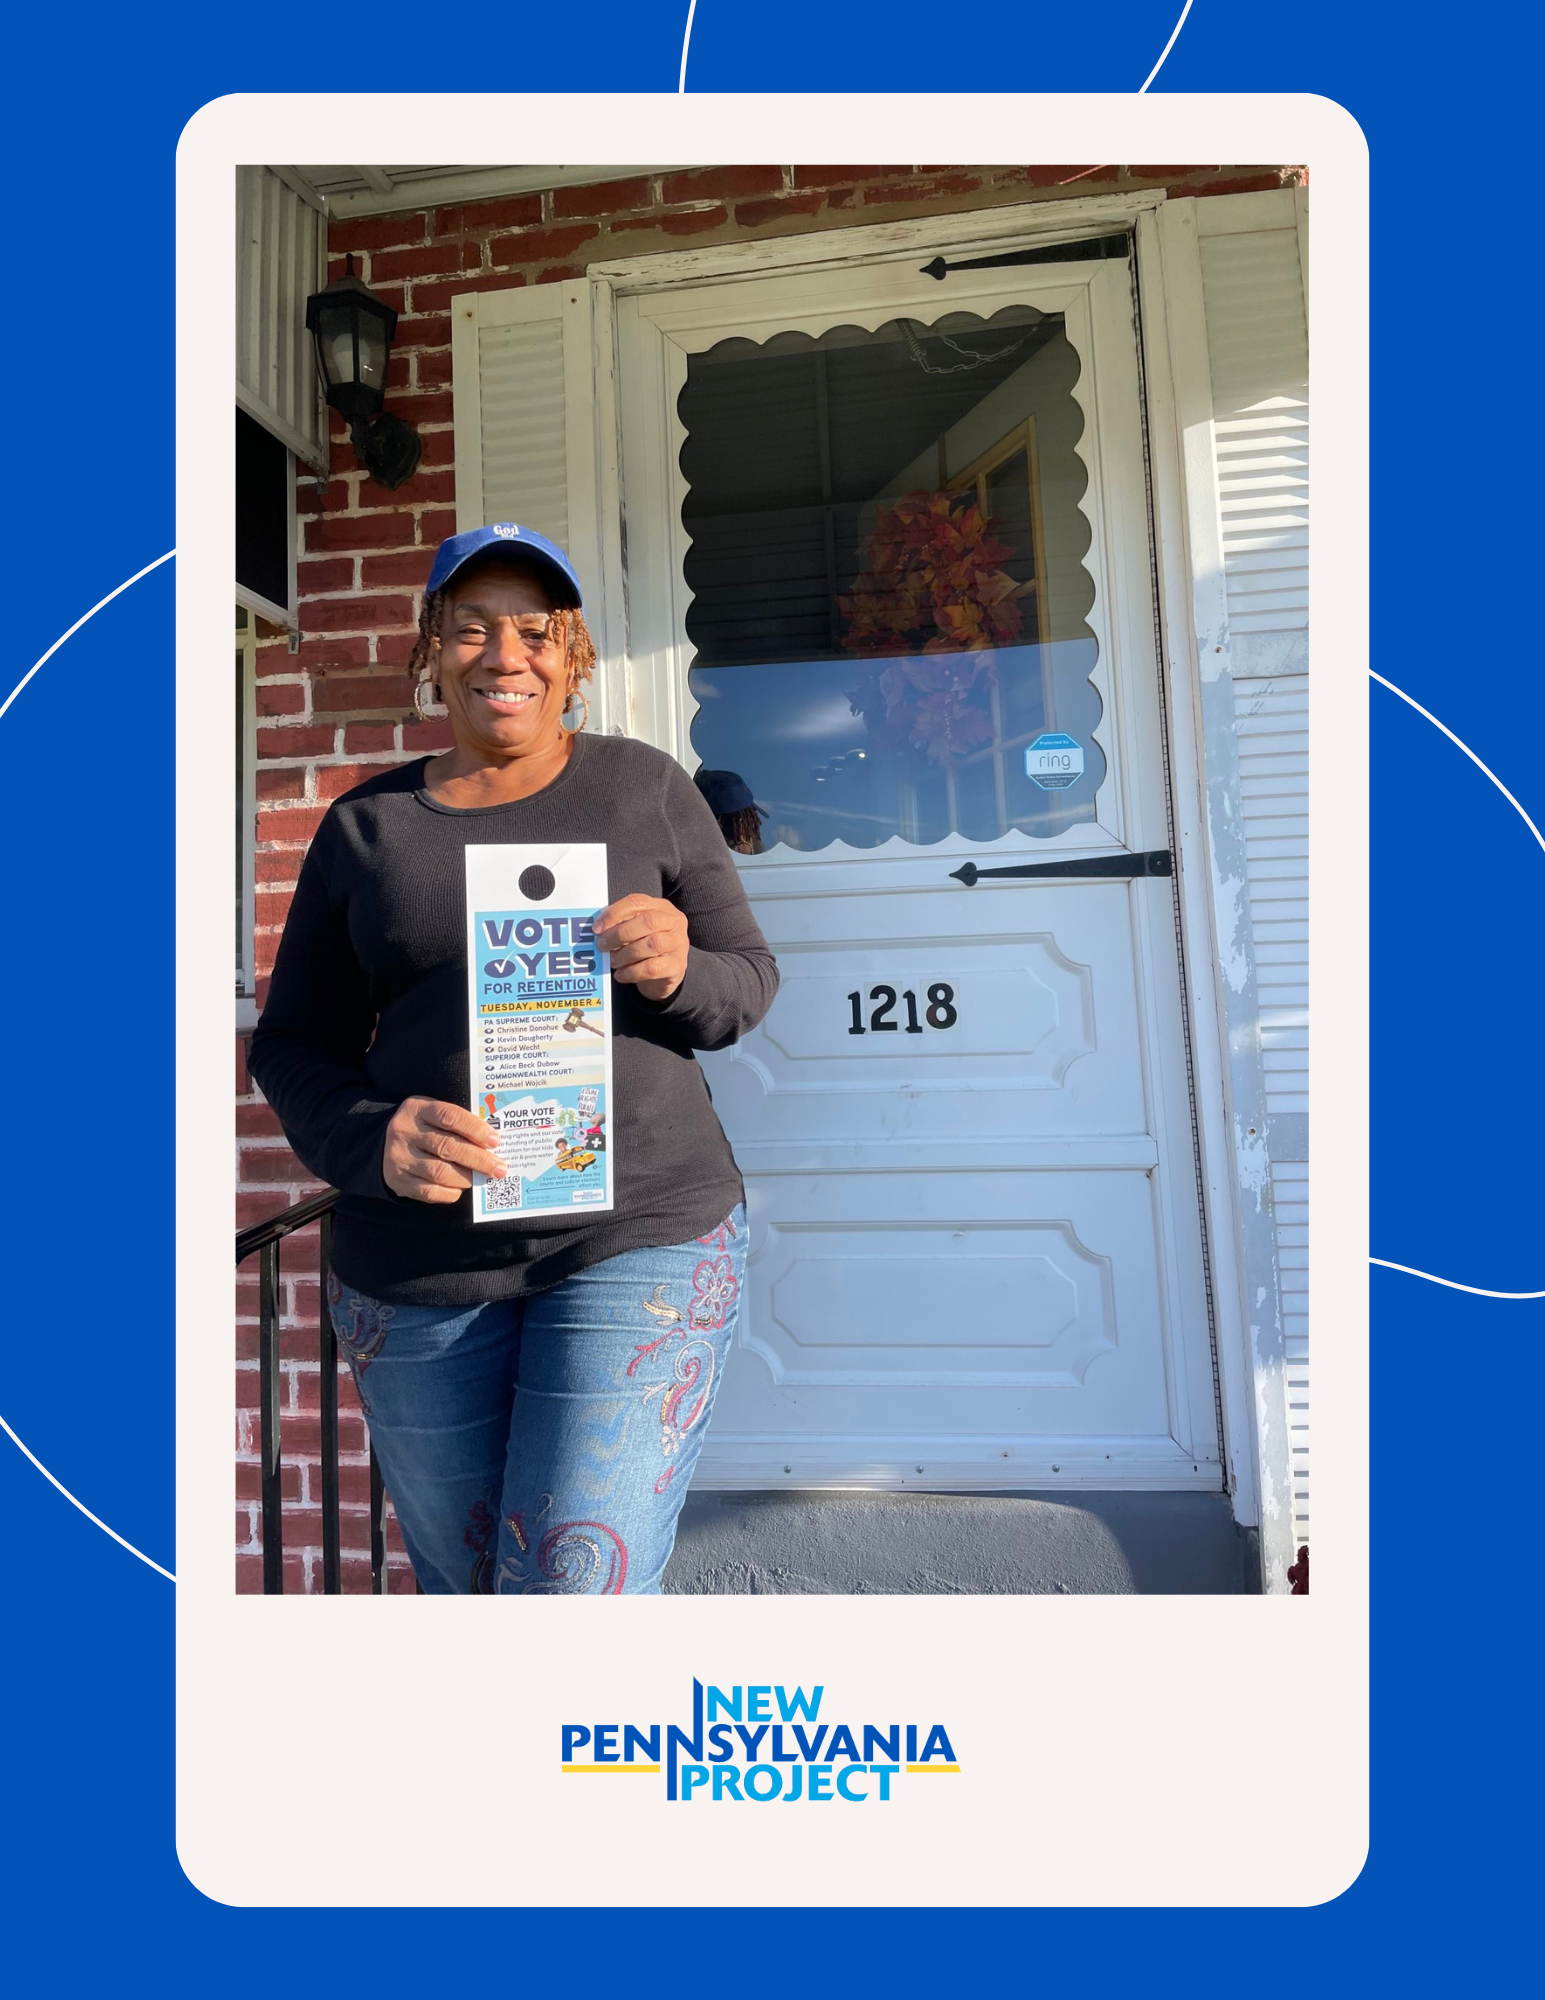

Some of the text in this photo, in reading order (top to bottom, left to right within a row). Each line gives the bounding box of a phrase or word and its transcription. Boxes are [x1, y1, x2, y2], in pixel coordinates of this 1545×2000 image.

[493, 525, 519, 535] God
[1039, 752, 1071, 770] ring
[482, 916, 595, 949] VOTE
[515, 950, 597, 979] YES
[484, 978, 596, 995] FOR RETENTION
[481, 1002, 532, 1013] TUESDAY,
[536, 999, 592, 1009] NOVEMBER
[847, 983, 958, 1035] 1218
[496, 1017, 530, 1025] SUPREME
[497, 1024, 559, 1034] Christine Donohue
[518, 1034, 553, 1042] Dougherty
[485, 1051, 549, 1061] SUPERIOR COURT:
[518, 1061, 535, 1069] Beck
[537, 1060, 560, 1068] Dubow
[485, 1068, 575, 1080] COMMONWEALTH COURT:
[498, 1080, 547, 1089] Michael Wojcik
[503, 1107, 555, 1118] YOUR VOTE
[503, 1117, 554, 1128] PROTECTS:
